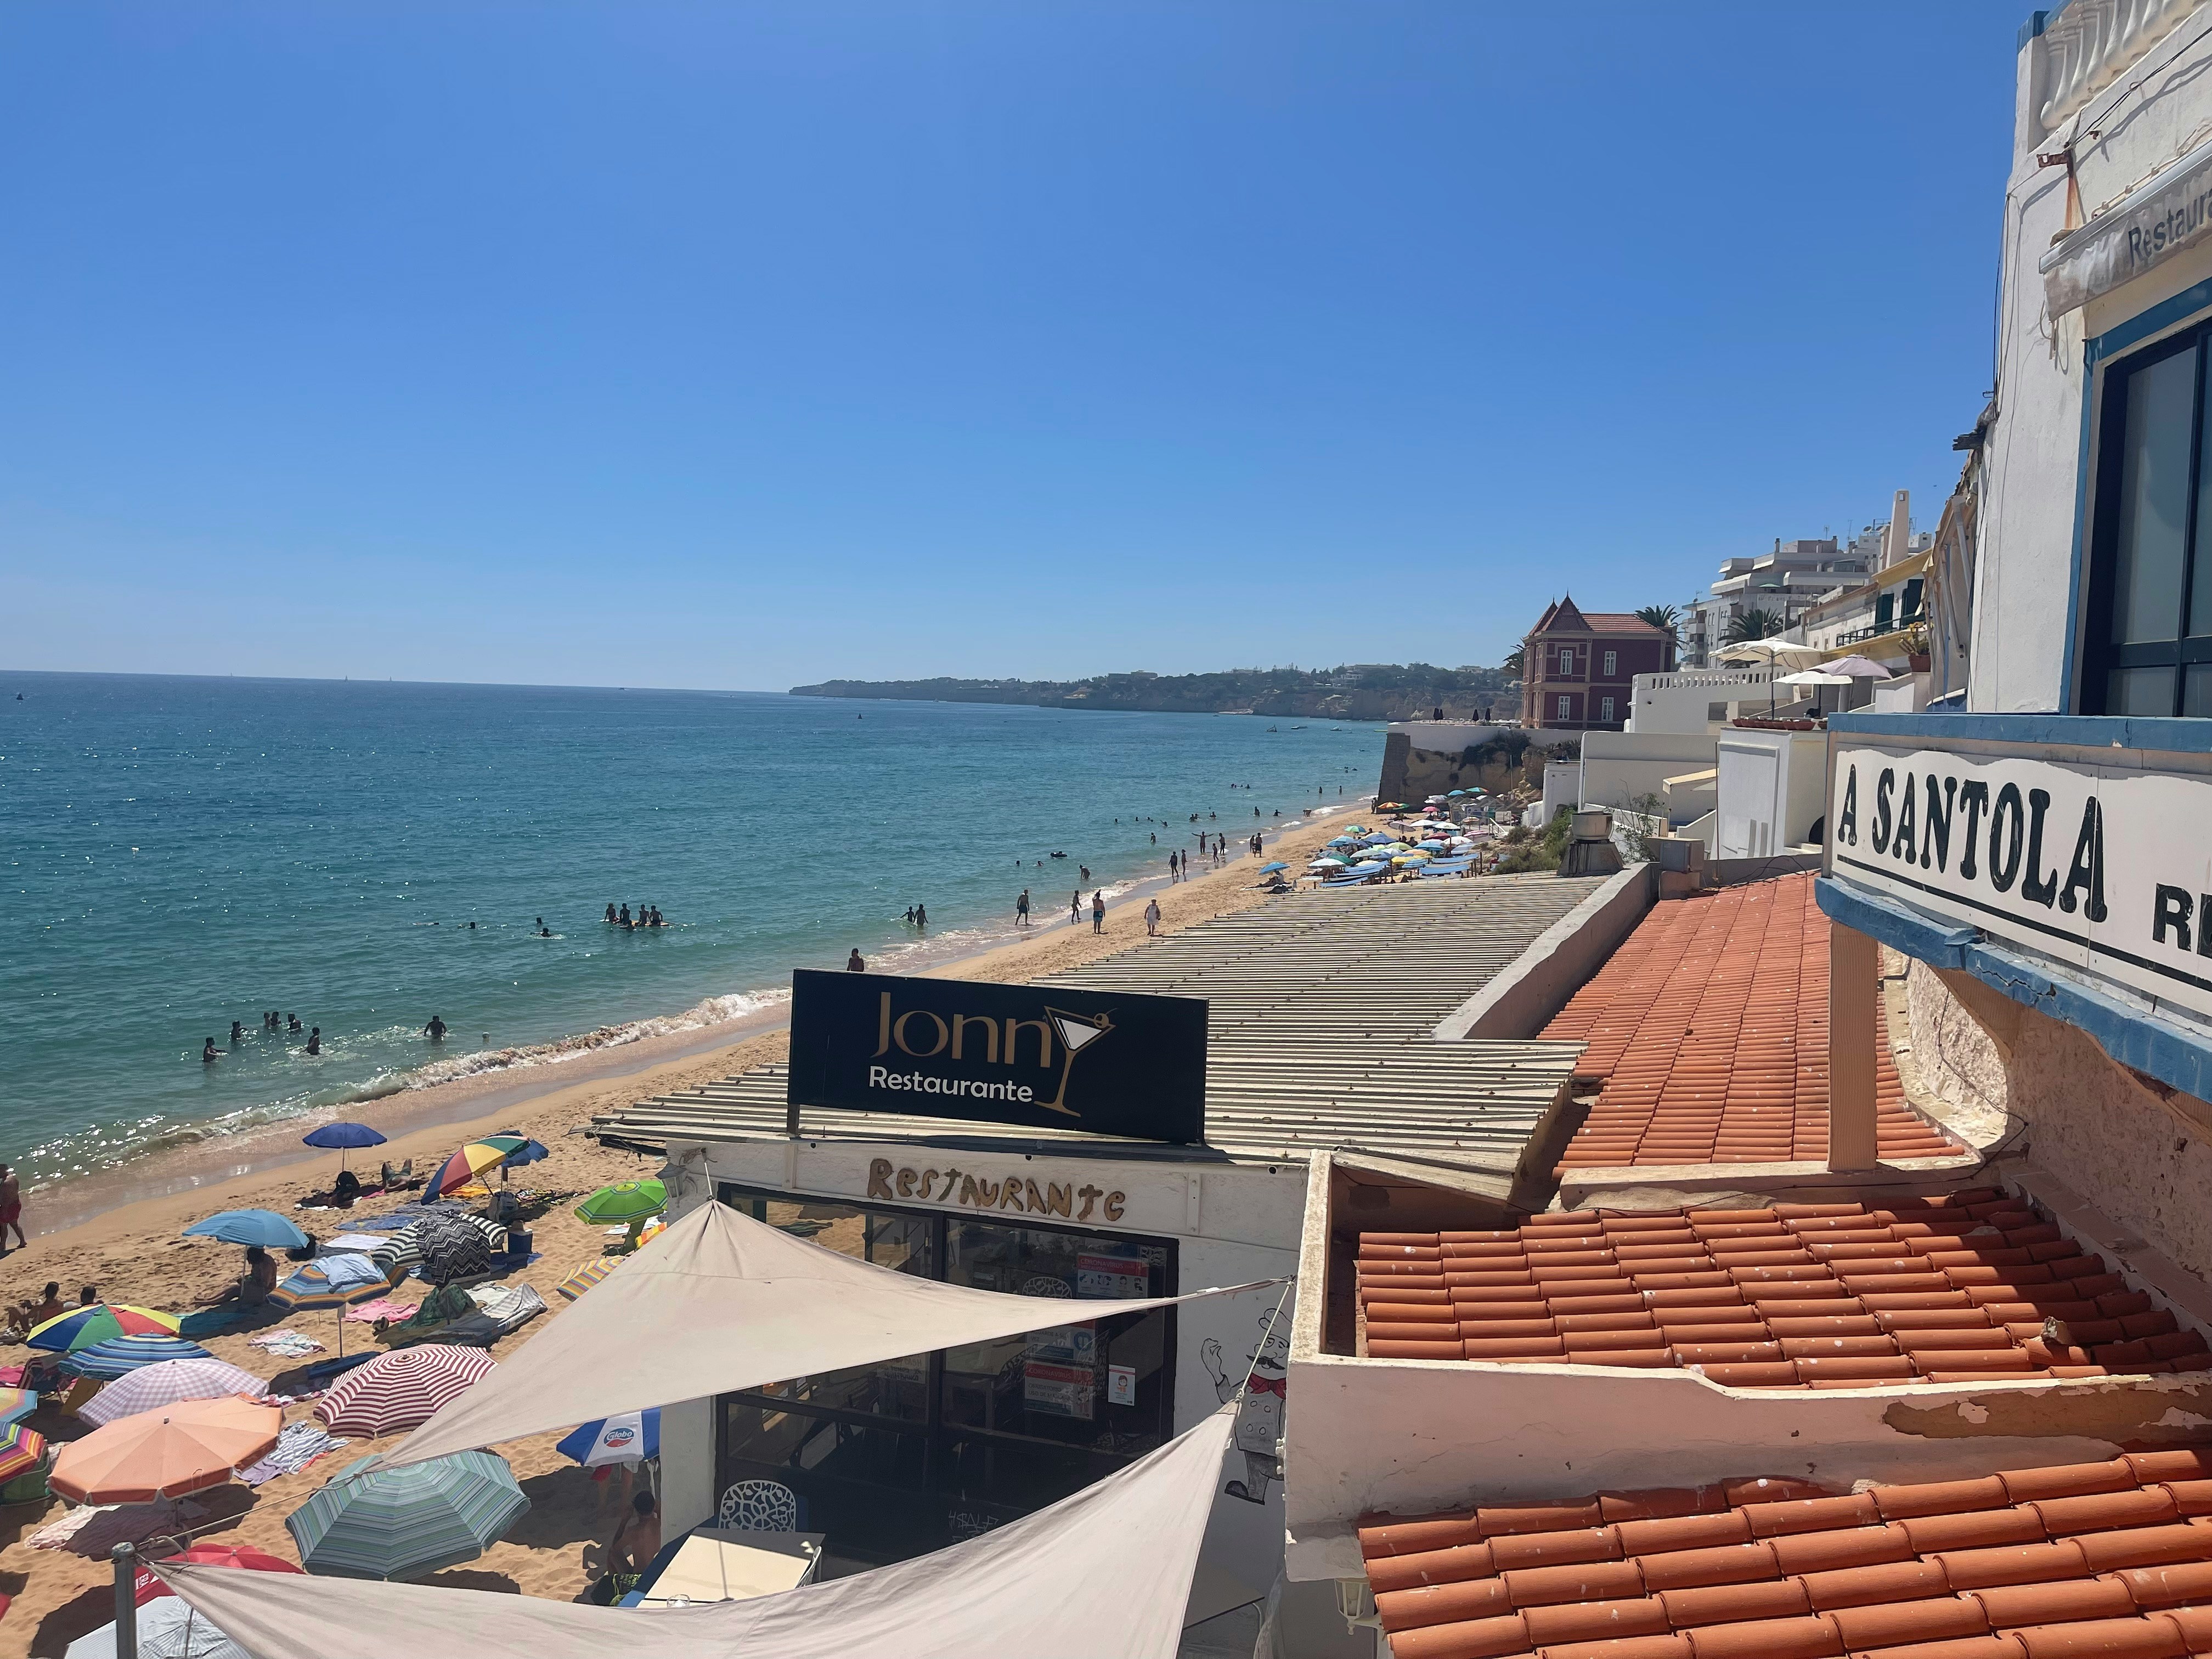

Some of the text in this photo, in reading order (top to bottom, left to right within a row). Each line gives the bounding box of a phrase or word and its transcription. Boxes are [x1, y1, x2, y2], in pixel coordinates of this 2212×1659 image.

[1838, 763, 1857, 846] A
[1872, 768, 2108, 923] SANTOLA
[868, 1065, 1033, 1102] Restaurante
[606, 1431, 633, 1441] Globo
